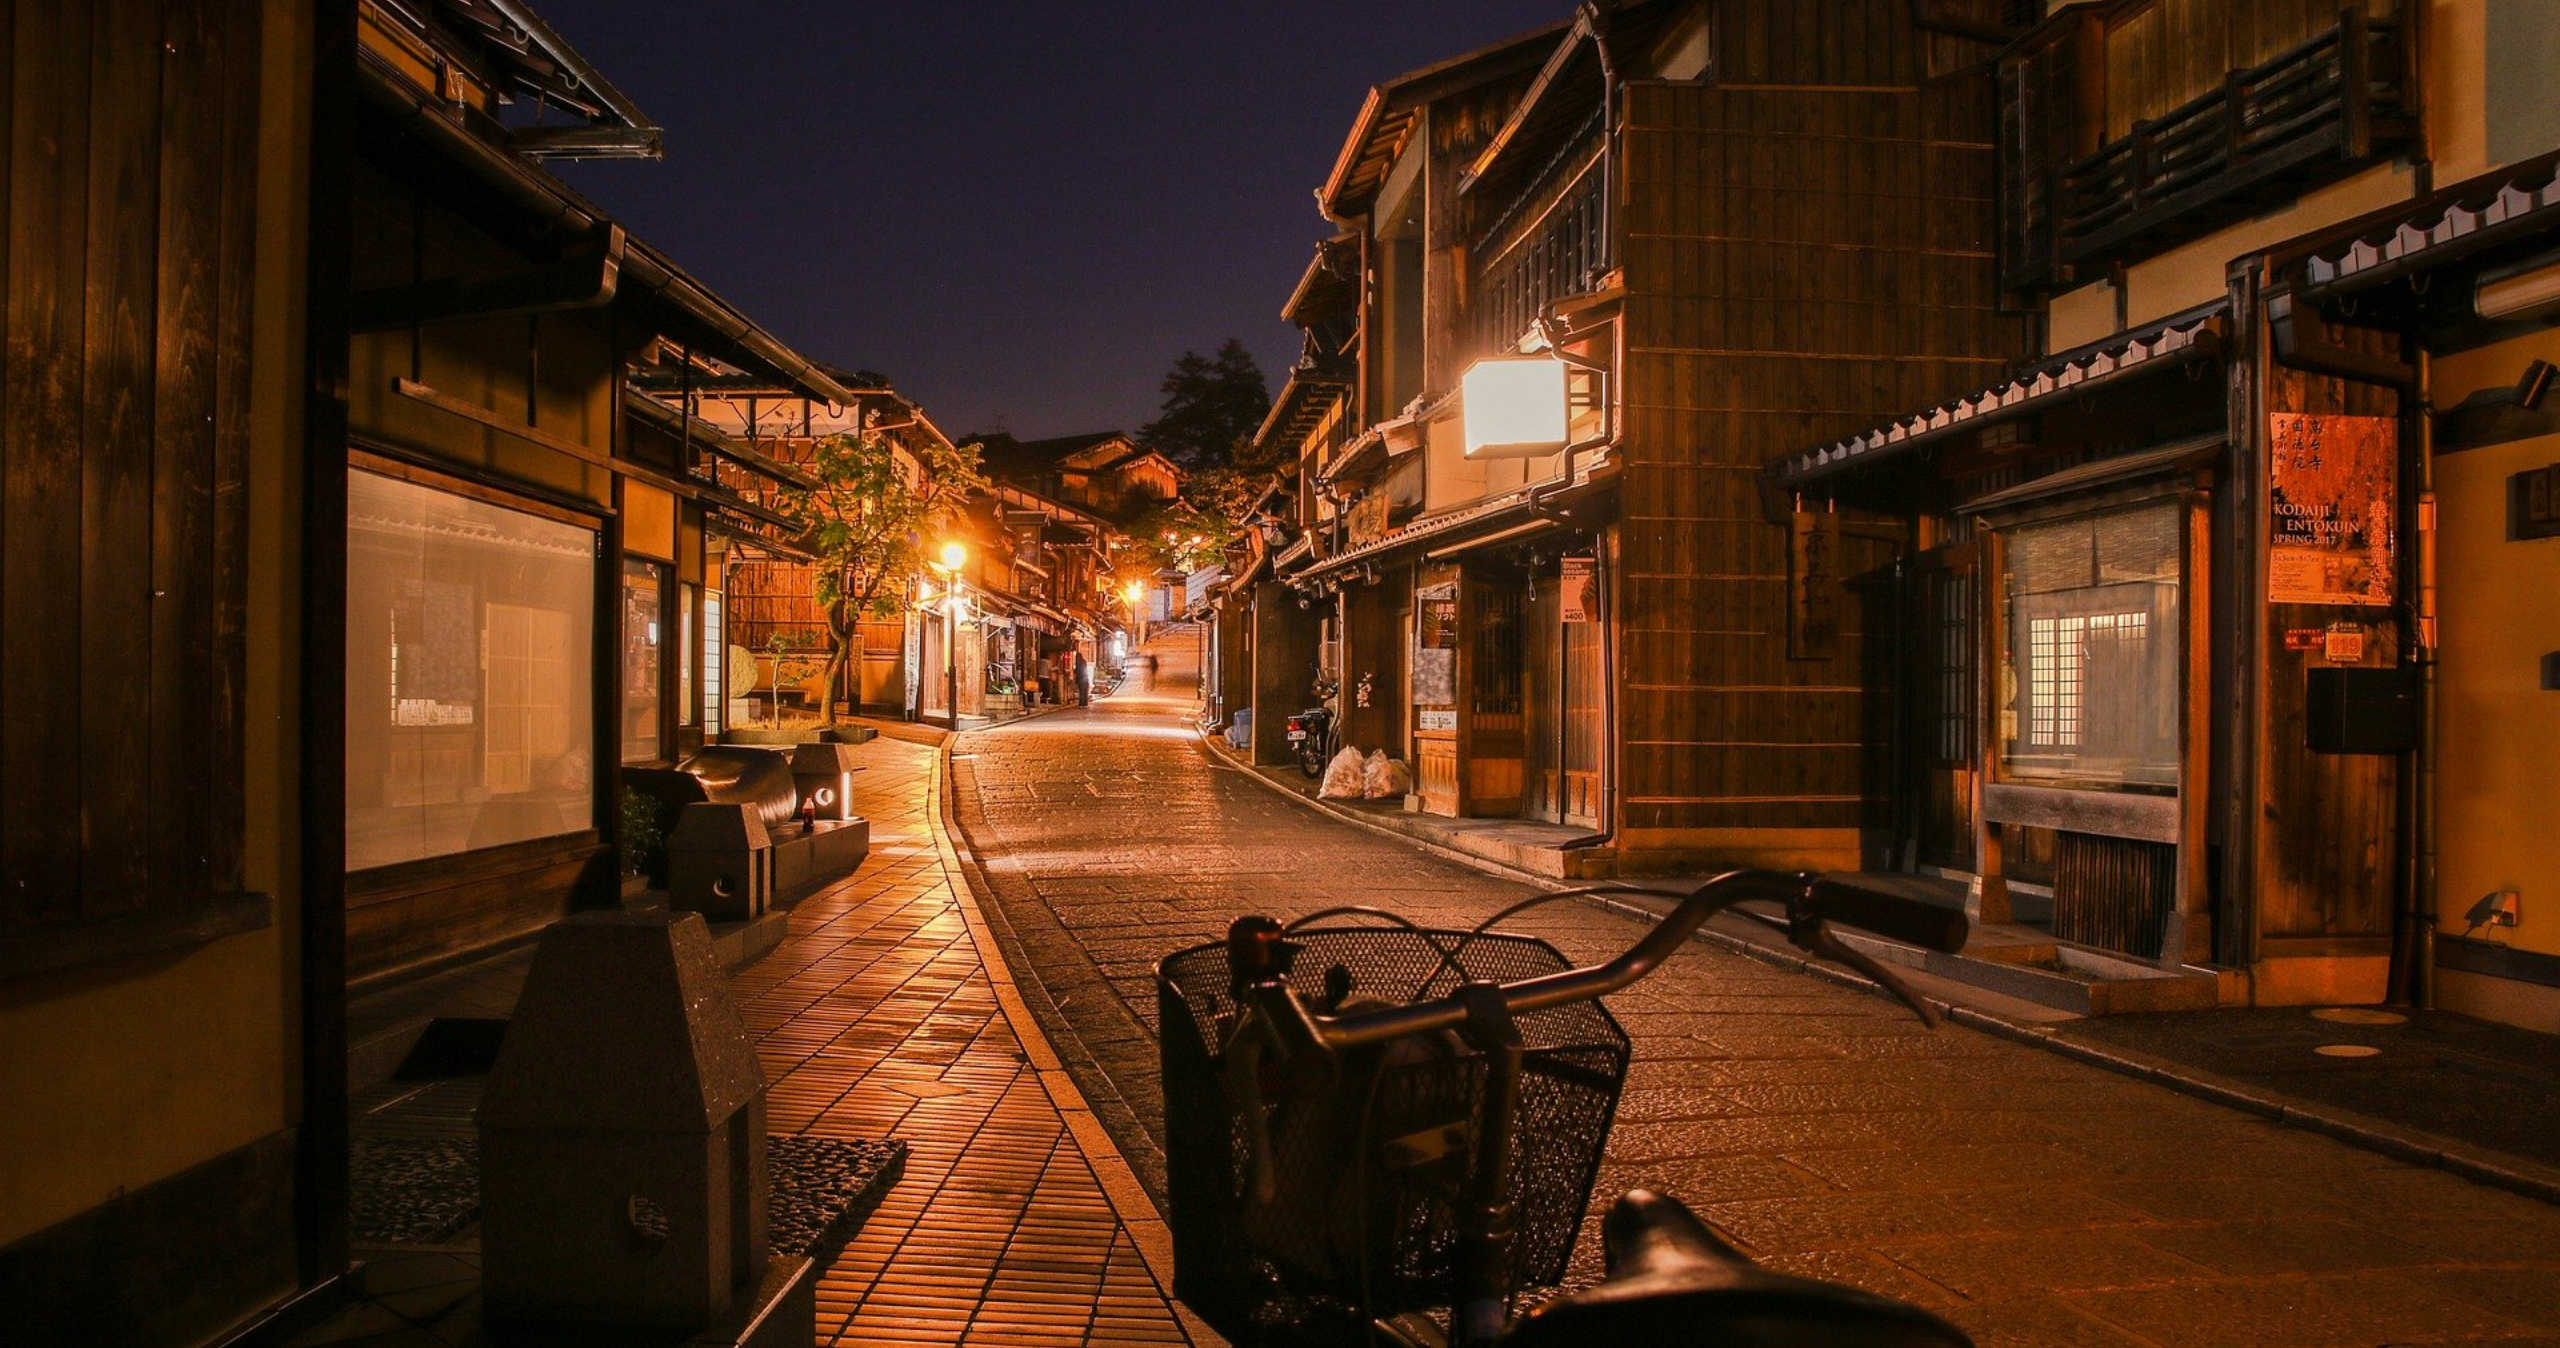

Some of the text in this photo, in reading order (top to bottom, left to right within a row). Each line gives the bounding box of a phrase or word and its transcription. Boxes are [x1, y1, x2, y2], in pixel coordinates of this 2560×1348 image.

[2274, 503, 2331, 516] KODAIJI
[2286, 519, 2360, 533] ENTOKUIN
[2273, 533, 2337, 545] SPRING 2017
[1435, 613, 1456, 621] ソフト
[2330, 636, 2360, 655] 119
